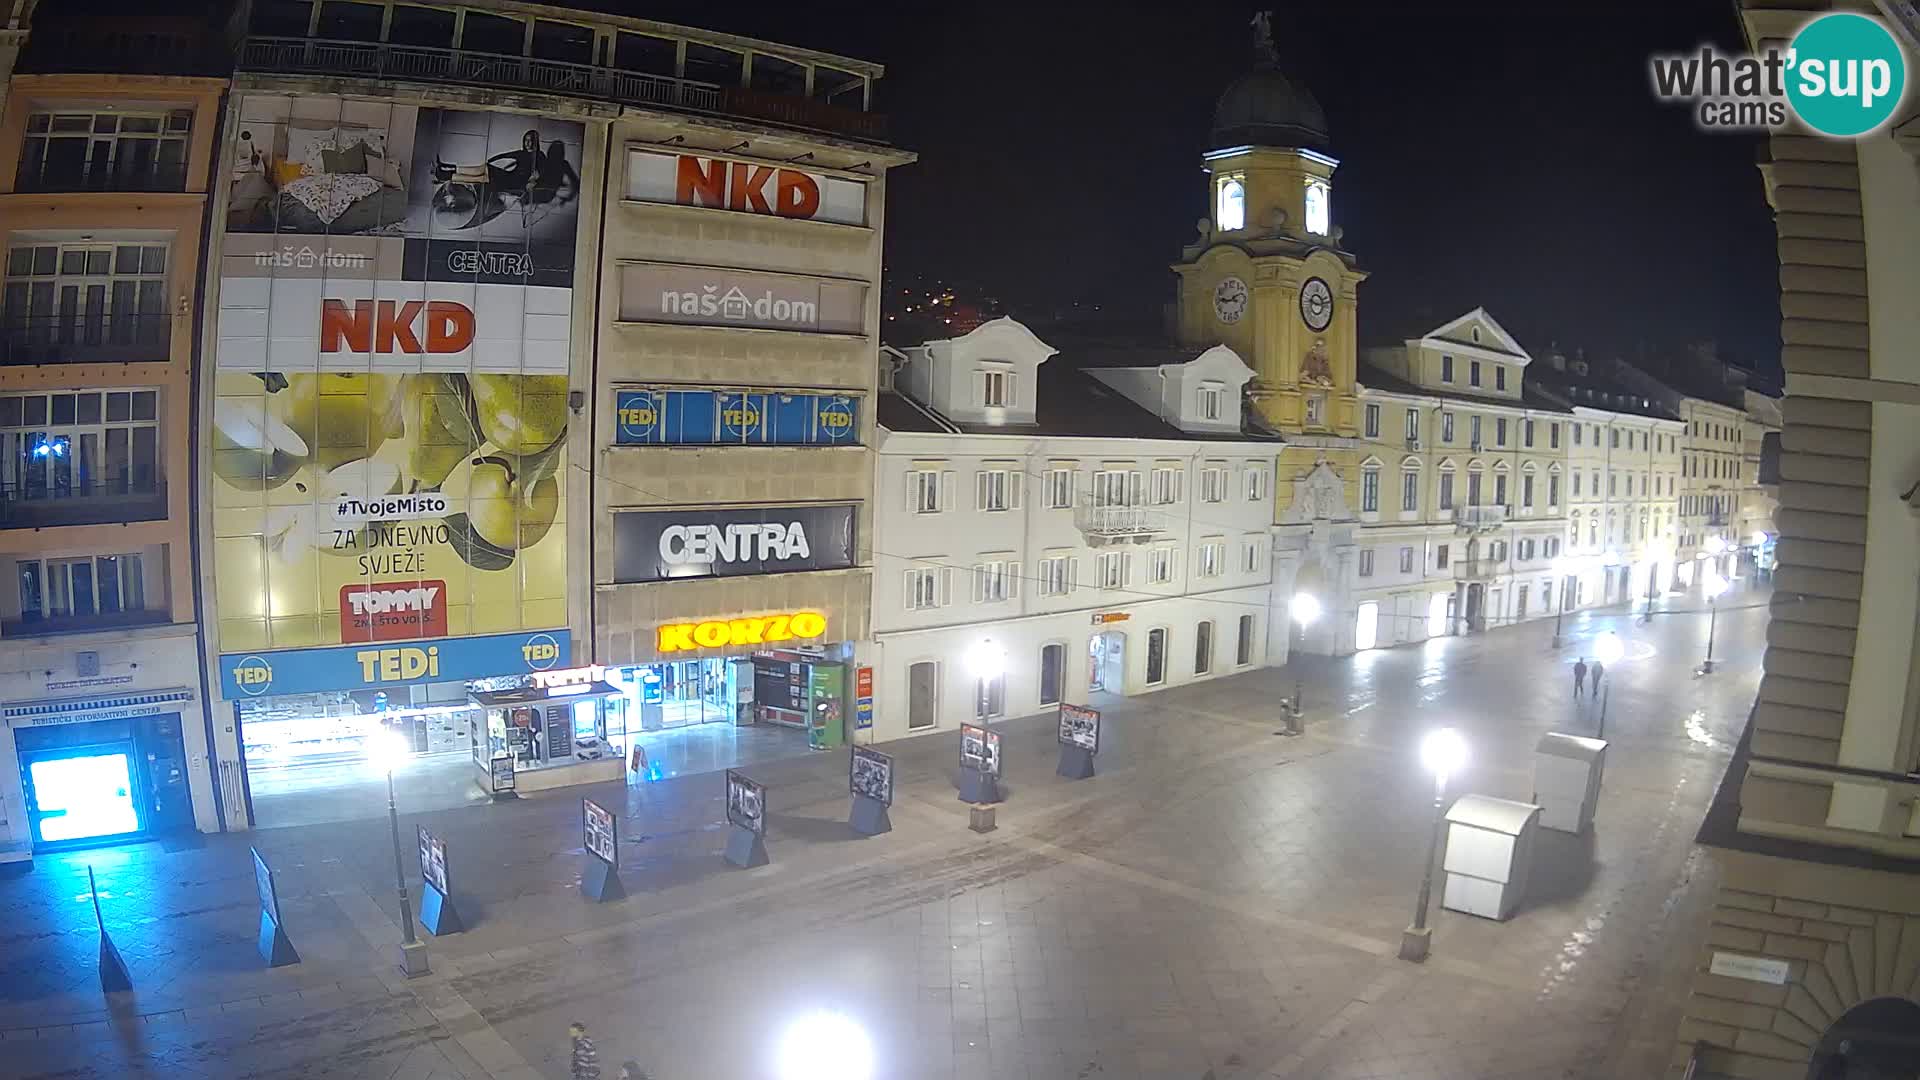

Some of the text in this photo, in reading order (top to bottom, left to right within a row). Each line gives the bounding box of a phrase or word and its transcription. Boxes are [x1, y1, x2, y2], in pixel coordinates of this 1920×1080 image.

[677, 155, 820, 220] NKD
[255, 246, 365, 268] naš dom
[447, 250, 535, 276] CENTRA
[661, 285, 816, 323] naš dom
[320, 298, 477, 354] NKD
[619, 408, 657, 426] TEDi
[723, 410, 760, 426] TEDi
[820, 412, 853, 427] TEDi
[337, 498, 445, 517] #TvojeMisto
[333, 524, 450, 550] ZA DNEVNO
[659, 522, 810, 565] CENTRA
[359, 548, 425, 575] SVJEŽE
[347, 586, 439, 615] TOMMY
[658, 613, 826, 652] KORZO
[357, 646, 440, 683] TEDi
[521, 643, 560, 661] TEDi
[232, 666, 273, 685] TEDi
